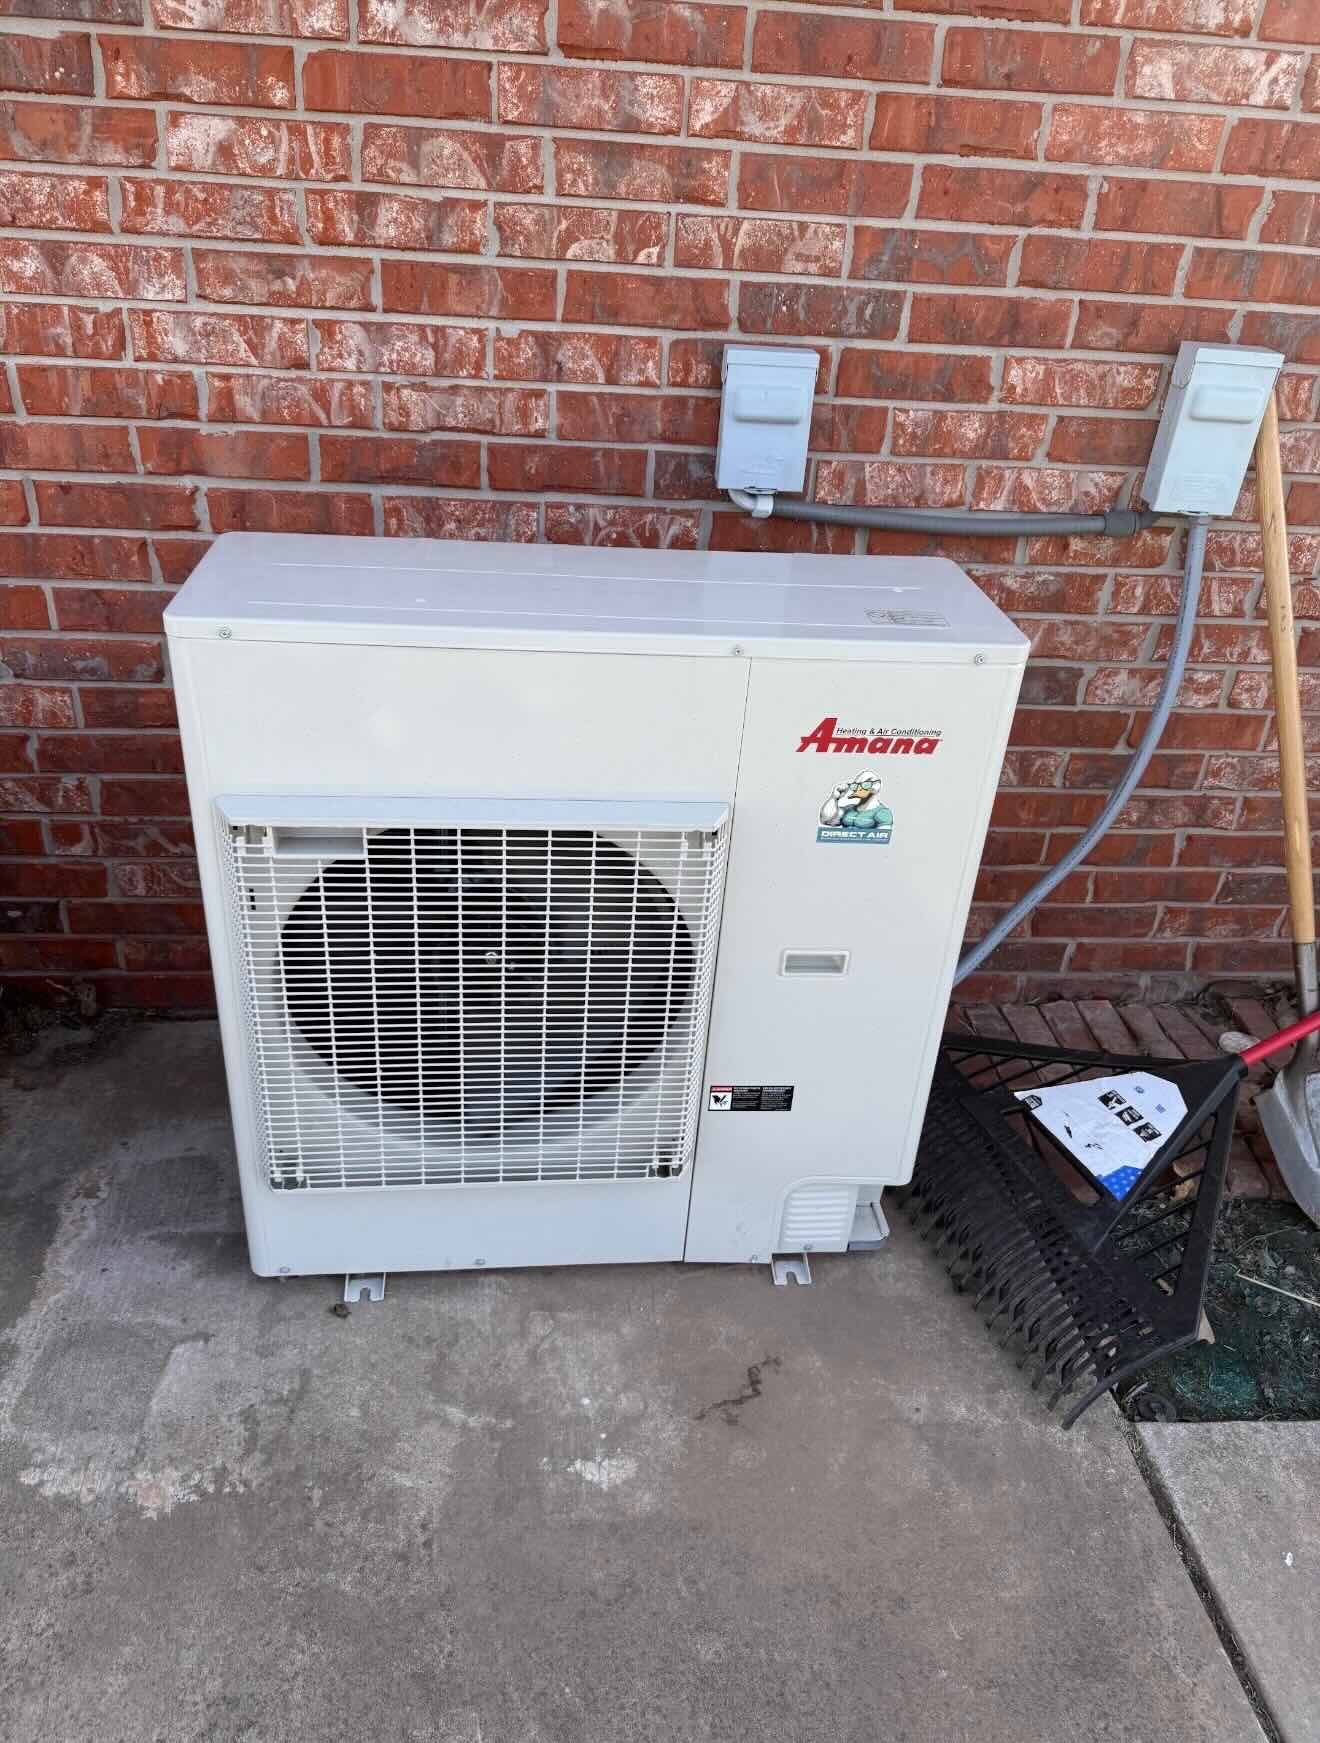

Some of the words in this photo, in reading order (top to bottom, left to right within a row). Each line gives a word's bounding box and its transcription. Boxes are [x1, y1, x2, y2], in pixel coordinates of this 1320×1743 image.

[796, 718, 940, 754] Amana
[836, 728, 867, 736] Heating
[876, 728, 889, 736] Air
[890, 728, 942, 737] Conditioning
